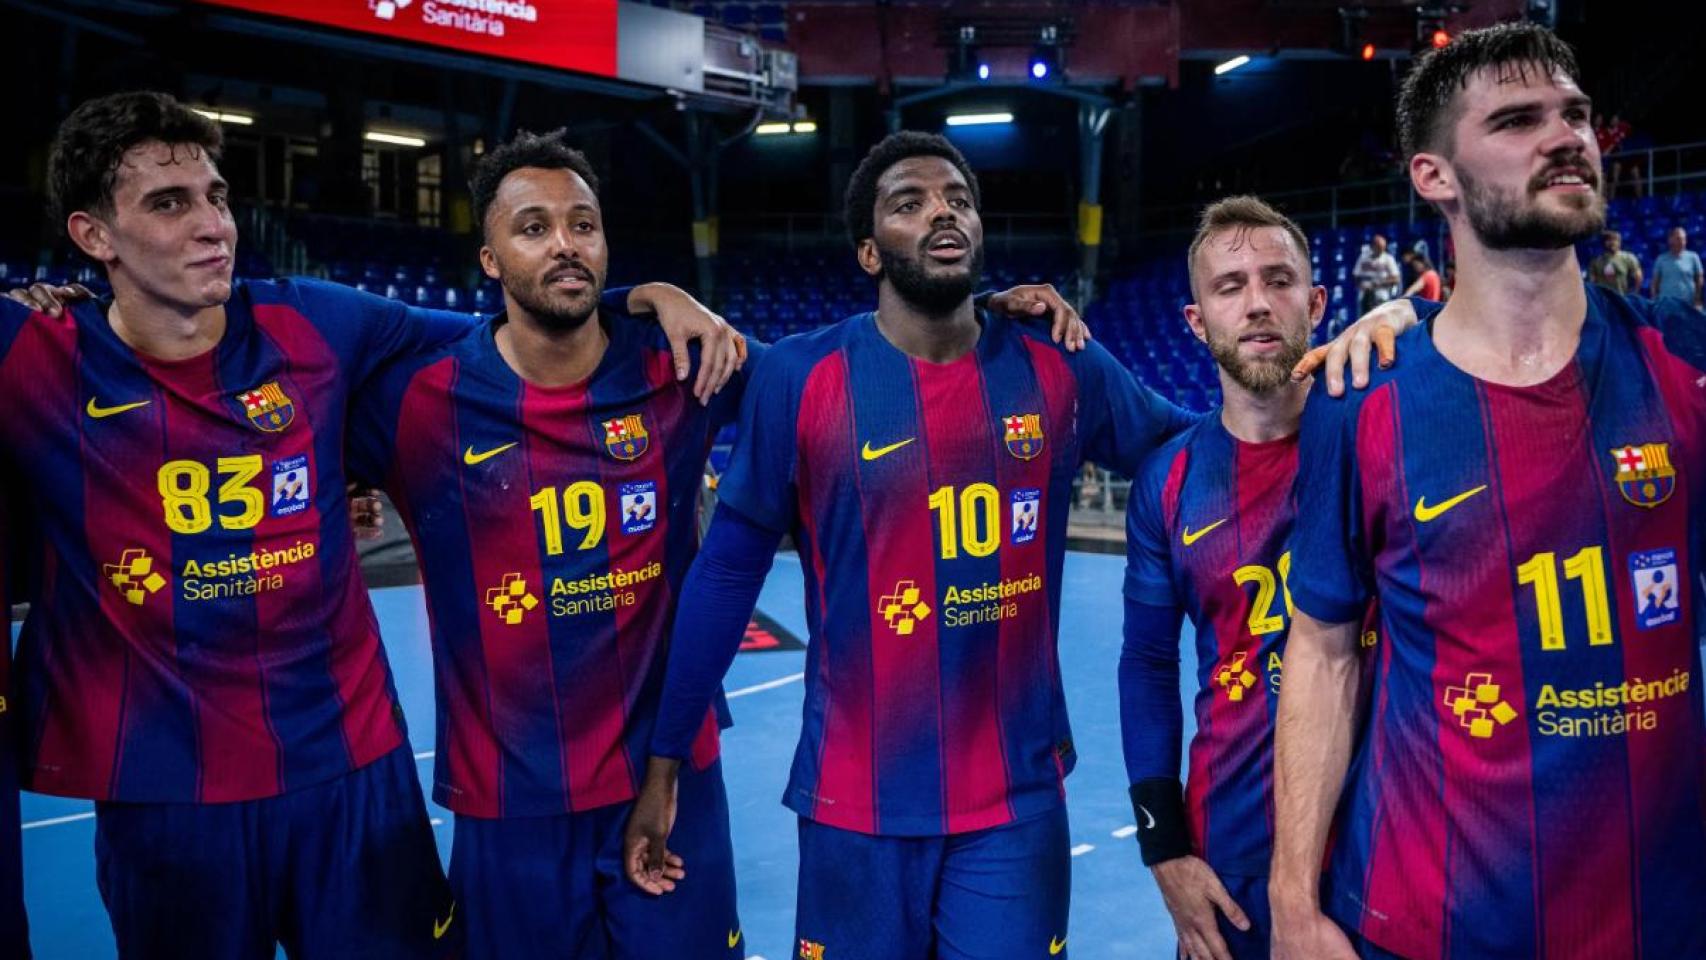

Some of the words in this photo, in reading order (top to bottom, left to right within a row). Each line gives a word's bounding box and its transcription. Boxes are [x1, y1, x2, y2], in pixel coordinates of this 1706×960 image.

[422, 1, 505, 37] Sanitària
[157, 454, 265, 534] 83
[530, 480, 607, 556] 19
[928, 482, 1001, 560] 10
[182, 541, 315, 579] Assistència
[183, 573, 283, 601] Sanitària
[551, 561, 661, 596] Assistència
[943, 573, 1042, 605] Assistència
[551, 589, 635, 617] Sanitària
[944, 600, 1018, 627] Sanitària
[1516, 545, 1613, 650] 11
[1536, 668, 1690, 708] Assistència
[1537, 706, 1657, 737] Sanitària
